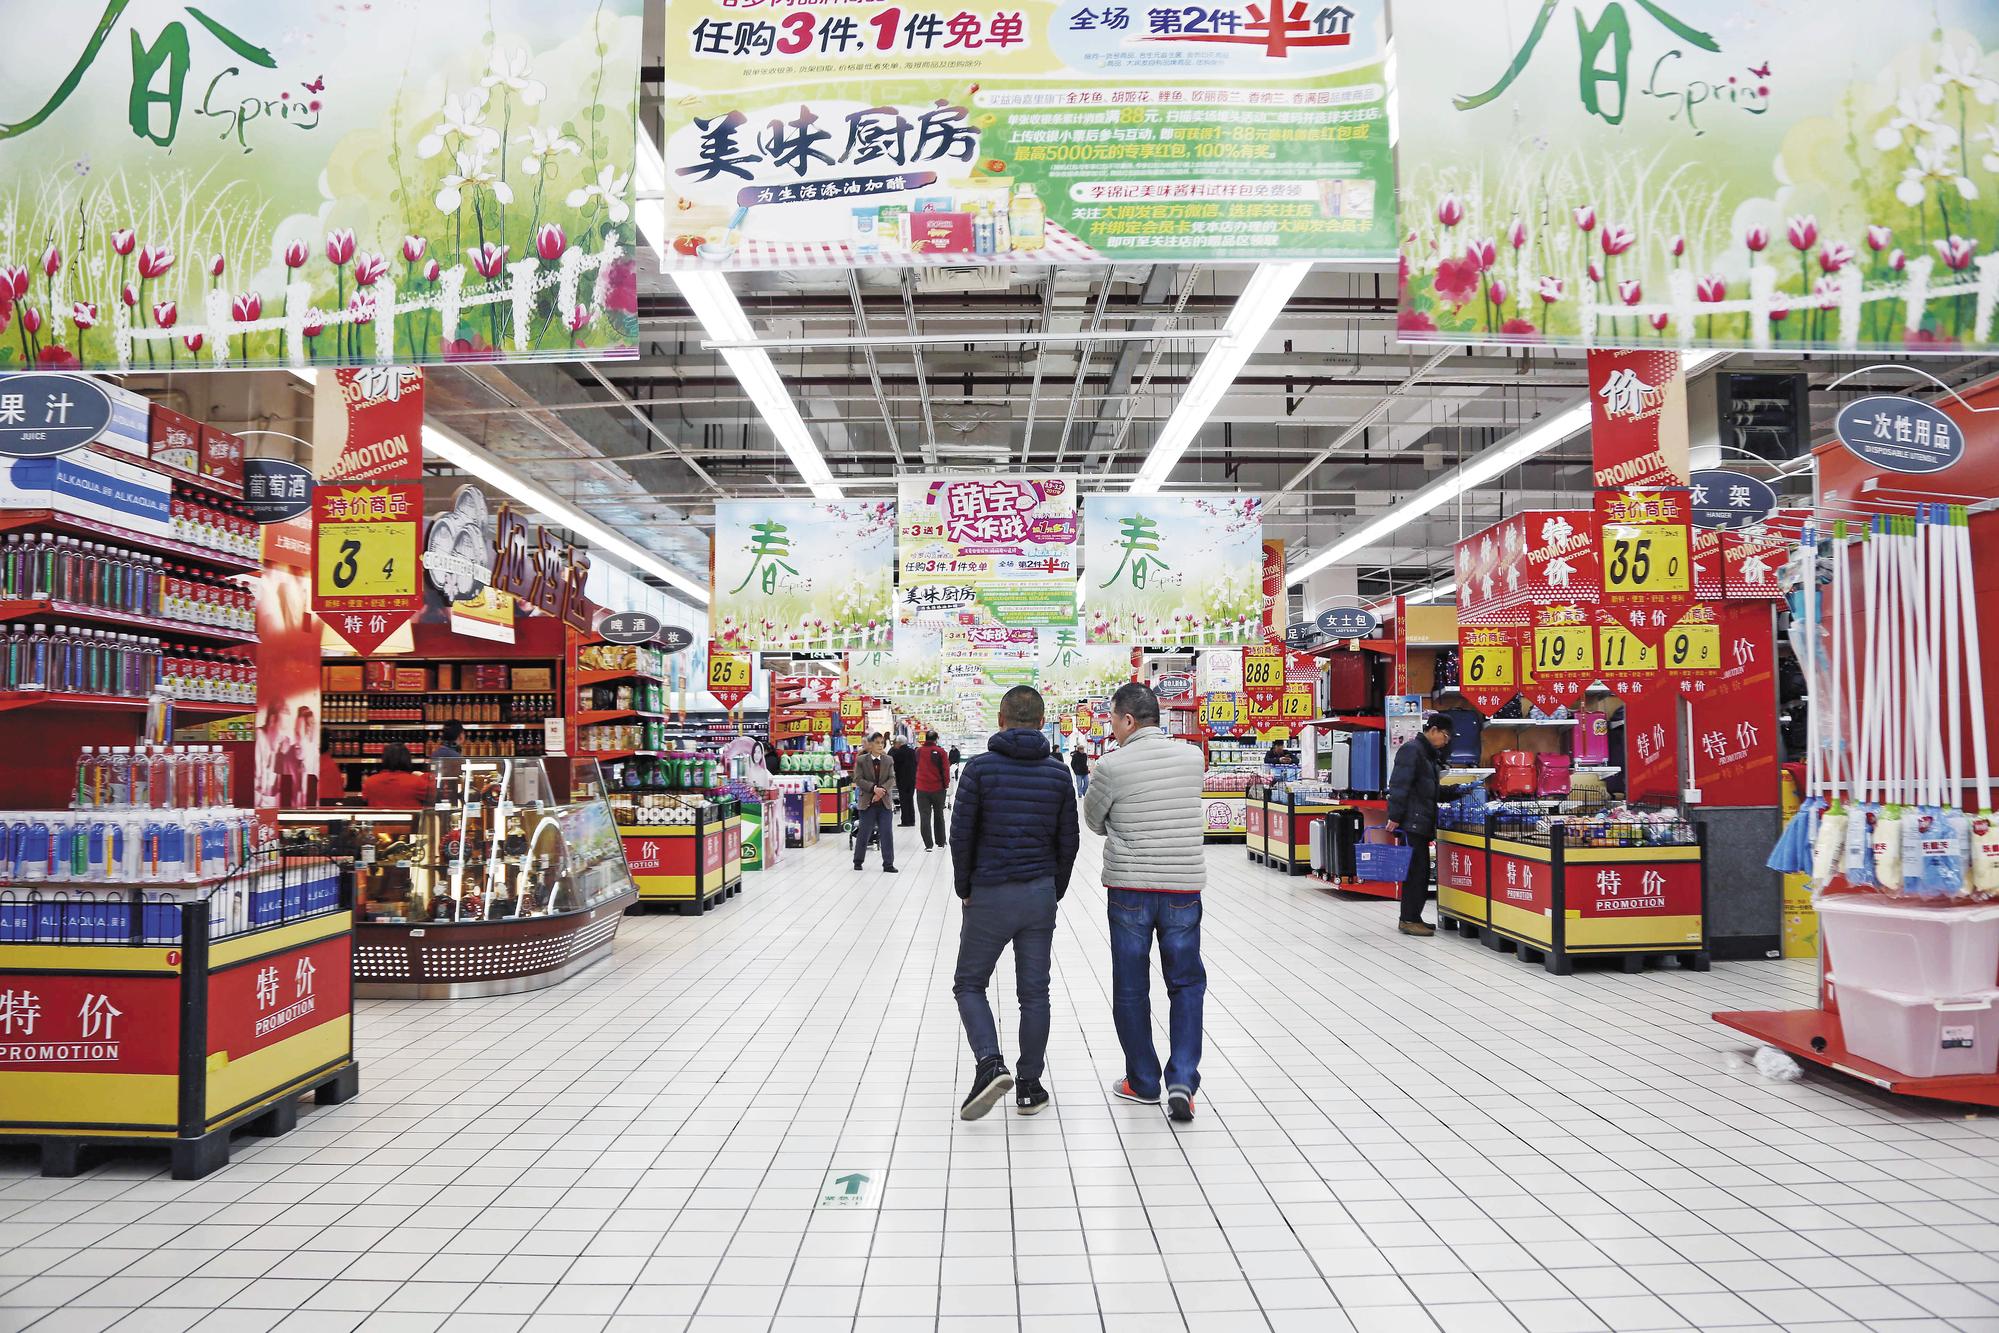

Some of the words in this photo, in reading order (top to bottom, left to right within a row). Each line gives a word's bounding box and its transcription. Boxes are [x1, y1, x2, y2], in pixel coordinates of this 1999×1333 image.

[1069, 7, 1130, 31] 全场
[1147, 0, 1354, 58] 第2件半价
[1641, 50, 1770, 137] Spring
[195, 66, 323, 154] Spring
[675, 99, 982, 183] 美味厨房
[757, 176, 907, 203] 为生活添油加醋
[1599, 368, 1656, 416] 价
[0, 392, 75, 425] 果汁
[20, 433, 47, 441] JUICE
[1853, 412, 1951, 450] 一次性用品
[249, 474, 306, 498] 葡萄酒
[1689, 485, 1752, 508] 衣架
[328, 495, 408, 517] 特价商品
[1609, 500, 1679, 519] 特价商品
[1706, 511, 1733, 519] HANGER
[949, 515, 1029, 546] 大作战
[333, 539, 361, 588] 3
[382, 558, 393, 580] 4
[729, 517, 800, 596] 春
[1099, 512, 1170, 590] 春
[1610, 539, 1651, 585] 35
[1668, 556, 1678, 577] 0
[903, 585, 977, 605] 美味厨房
[344, 613, 388, 634] 特价
[611, 618, 646, 632] 啤酒
[1326, 614, 1367, 627] 女士包
[1629, 609, 1668, 627] 特价
[1468, 630, 1508, 643] 特价商品
[1673, 634, 1690, 664] 9
[1701, 645, 1708, 659] 9
[1539, 635, 1566, 667] 19
[1576, 647, 1584, 660] 9
[1605, 635, 1627, 666] 11
[1639, 646, 1647, 660] 9
[1732, 637, 1755, 666] 价
[712, 661, 732, 682] 25
[739, 669, 745, 680] 5
[1246, 662, 1270, 682] 288
[1274, 670, 1281, 680] 0
[1470, 654, 1485, 681] 6
[1255, 693, 1274, 701] 特价
[1553, 682, 1579, 694] 特价
[1617, 681, 1643, 693] 特价
[1680, 680, 1706, 692] 特价
[1210, 706, 1223, 719] 14
[1285, 698, 1299, 714] 12
[1477, 695, 1500, 706] 特价
[1637, 723, 1665, 759] 特价
[1702, 721, 1759, 760] 特价
[1451, 851, 1473, 877] 特价
[1506, 861, 1533, 890] 特价
[1507, 890, 1533, 900] PROMOTION
[1596, 869, 1668, 896] 特价
[1596, 898, 1666, 911] PROMOTION
[171, 952, 177, 963] 1
[256, 957, 317, 1011] 特价
[0, 989, 123, 1040] 特价
[255, 997, 315, 1036] PROMOTION
